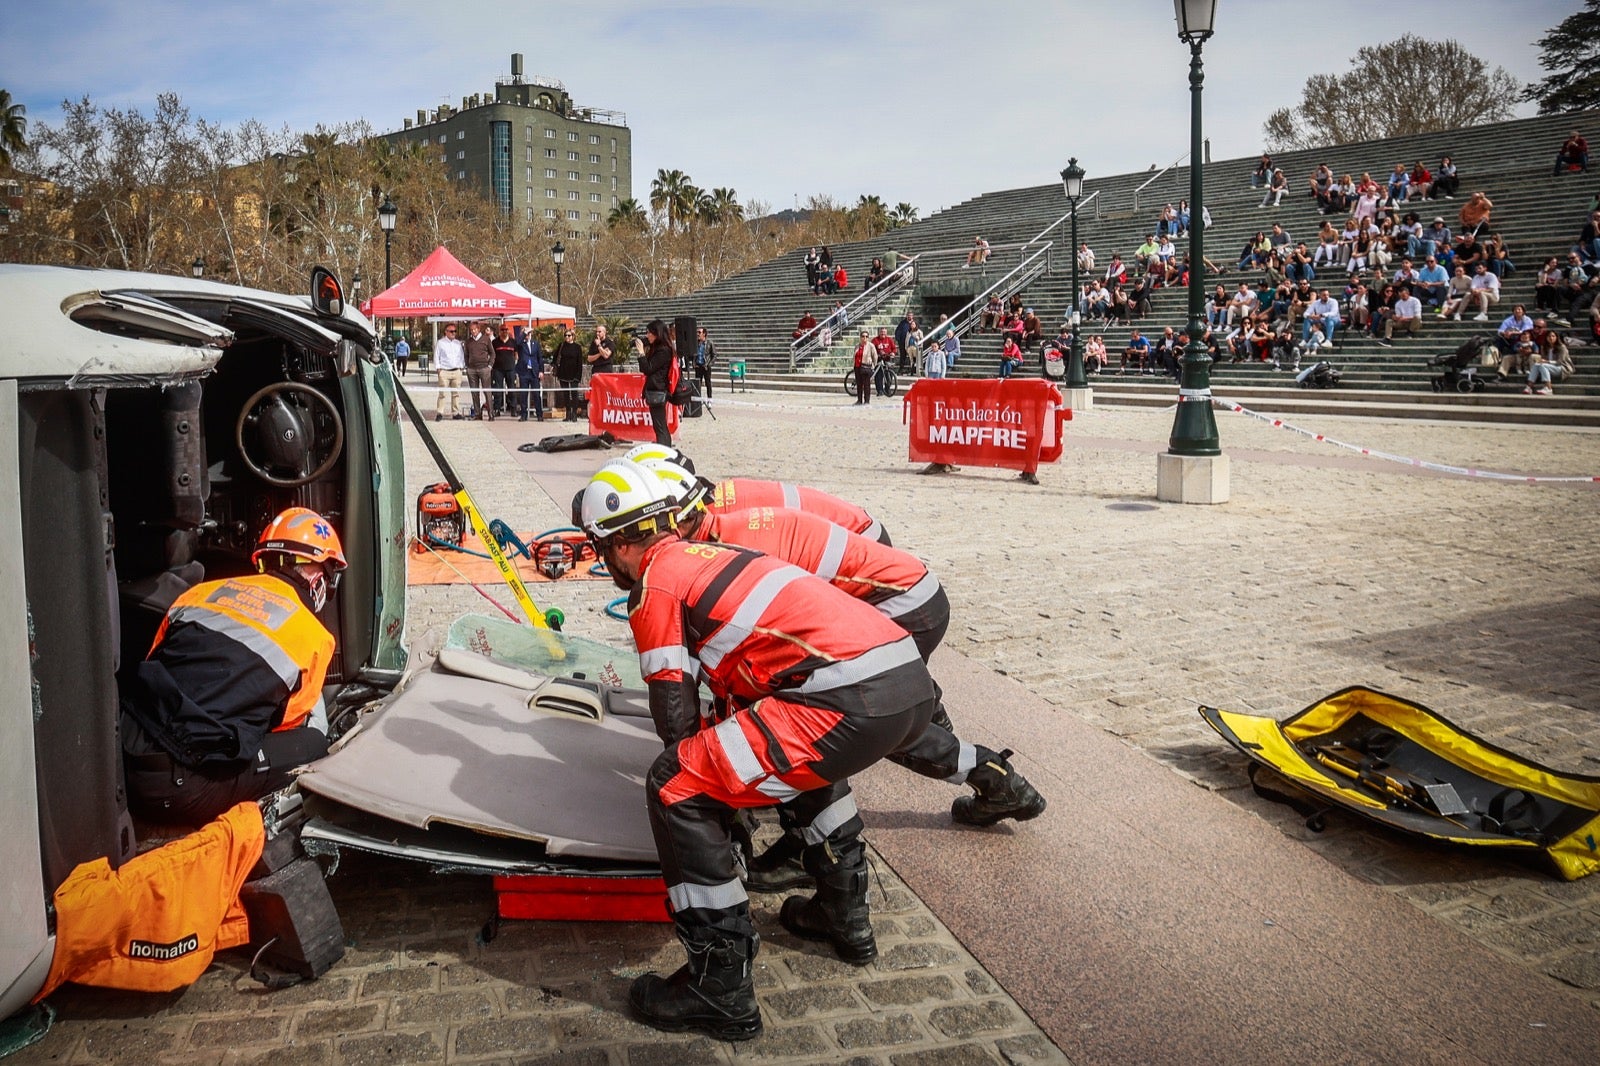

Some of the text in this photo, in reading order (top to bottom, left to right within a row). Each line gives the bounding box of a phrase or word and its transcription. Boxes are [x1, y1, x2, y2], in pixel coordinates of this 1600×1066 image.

[419, 280, 476, 289] MAPFRE
[421, 274, 472, 284] Fundación
[399, 298, 507, 309] Fundación MAPFRE
[606, 391, 650, 409] Fundaci
[602, 409, 654, 426] MAPFR
[933, 401, 1023, 424] Fundación
[929, 425, 1028, 450] MAPFRE
[131, 938, 197, 958] holmatro
